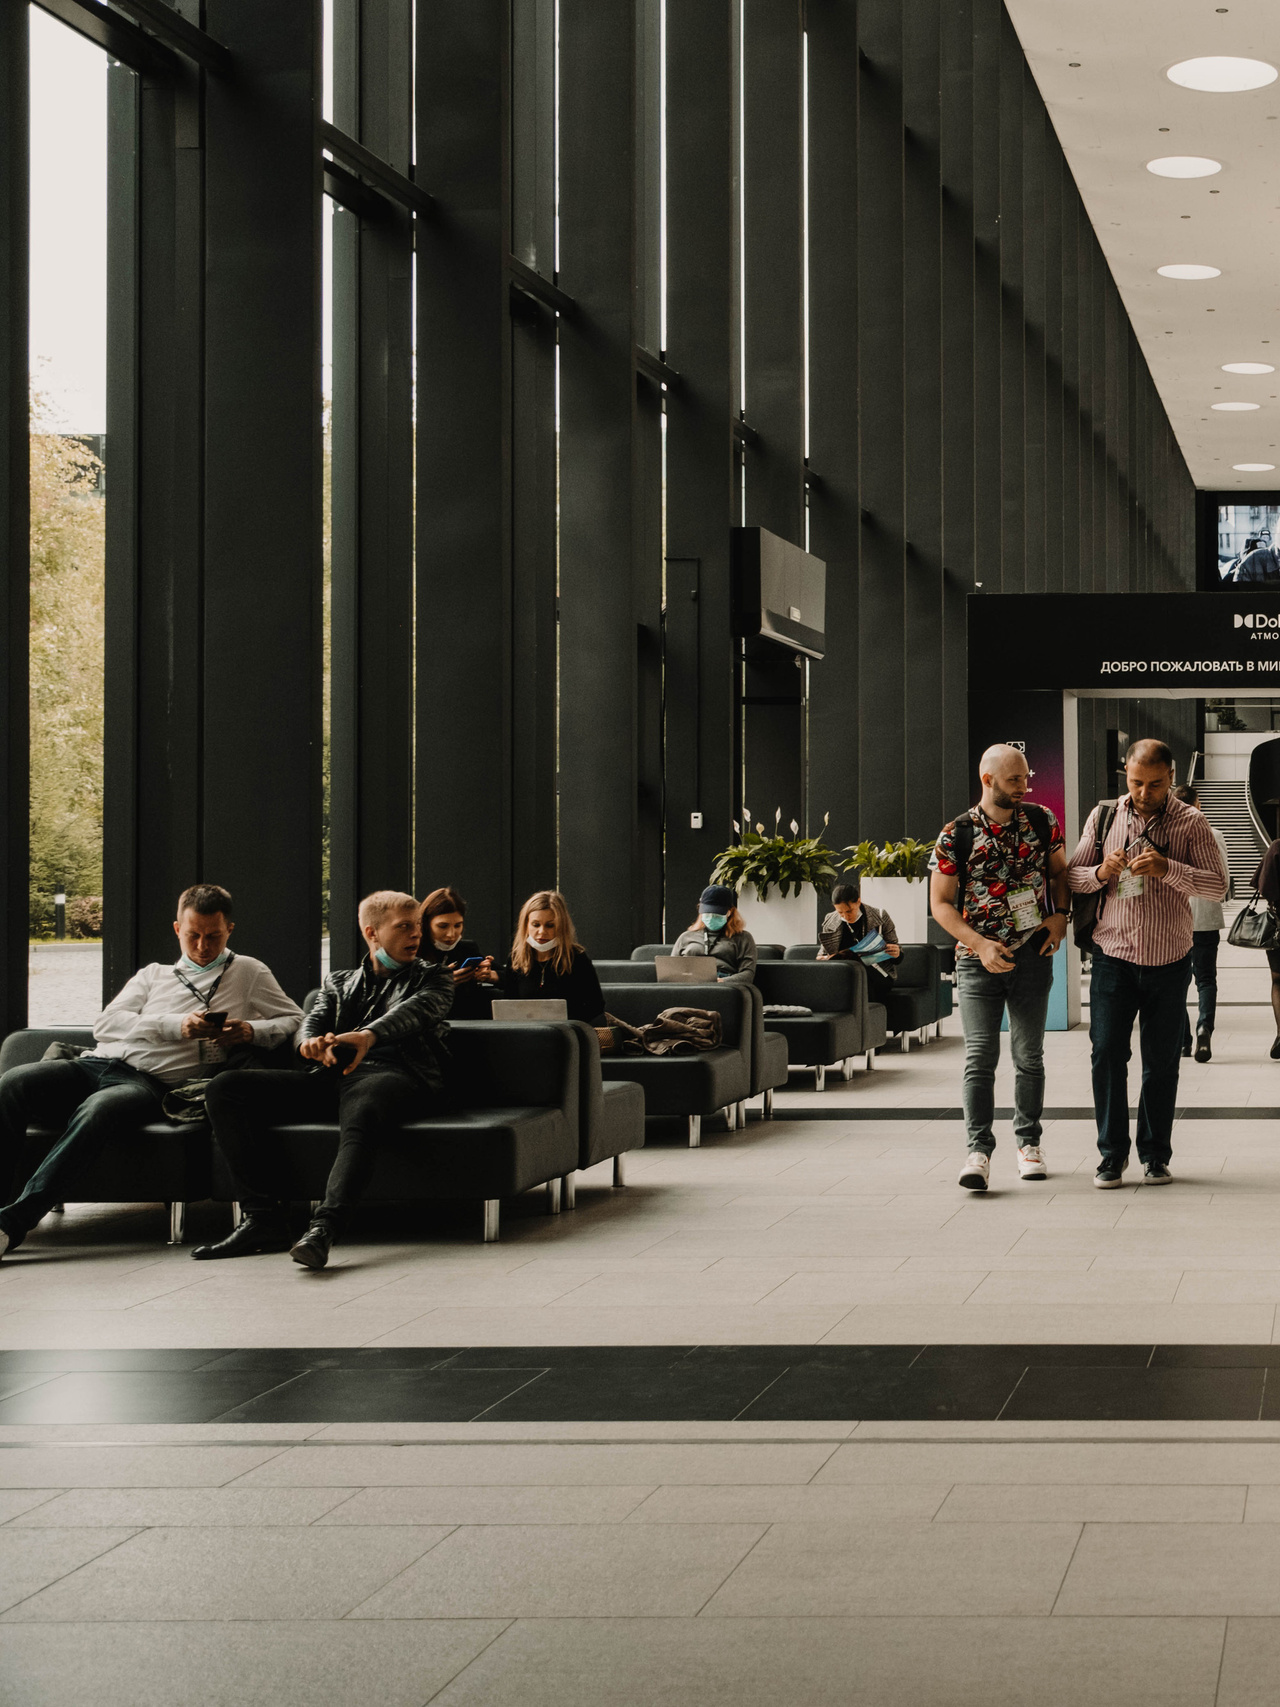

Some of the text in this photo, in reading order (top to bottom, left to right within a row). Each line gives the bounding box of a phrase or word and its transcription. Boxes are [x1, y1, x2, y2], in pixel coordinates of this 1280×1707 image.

[1100, 661, 1148, 674] ДОБРО
[1150, 661, 1244, 672] ПОЖАЛОВАТЬ
[1246, 661, 1255, 672] В
